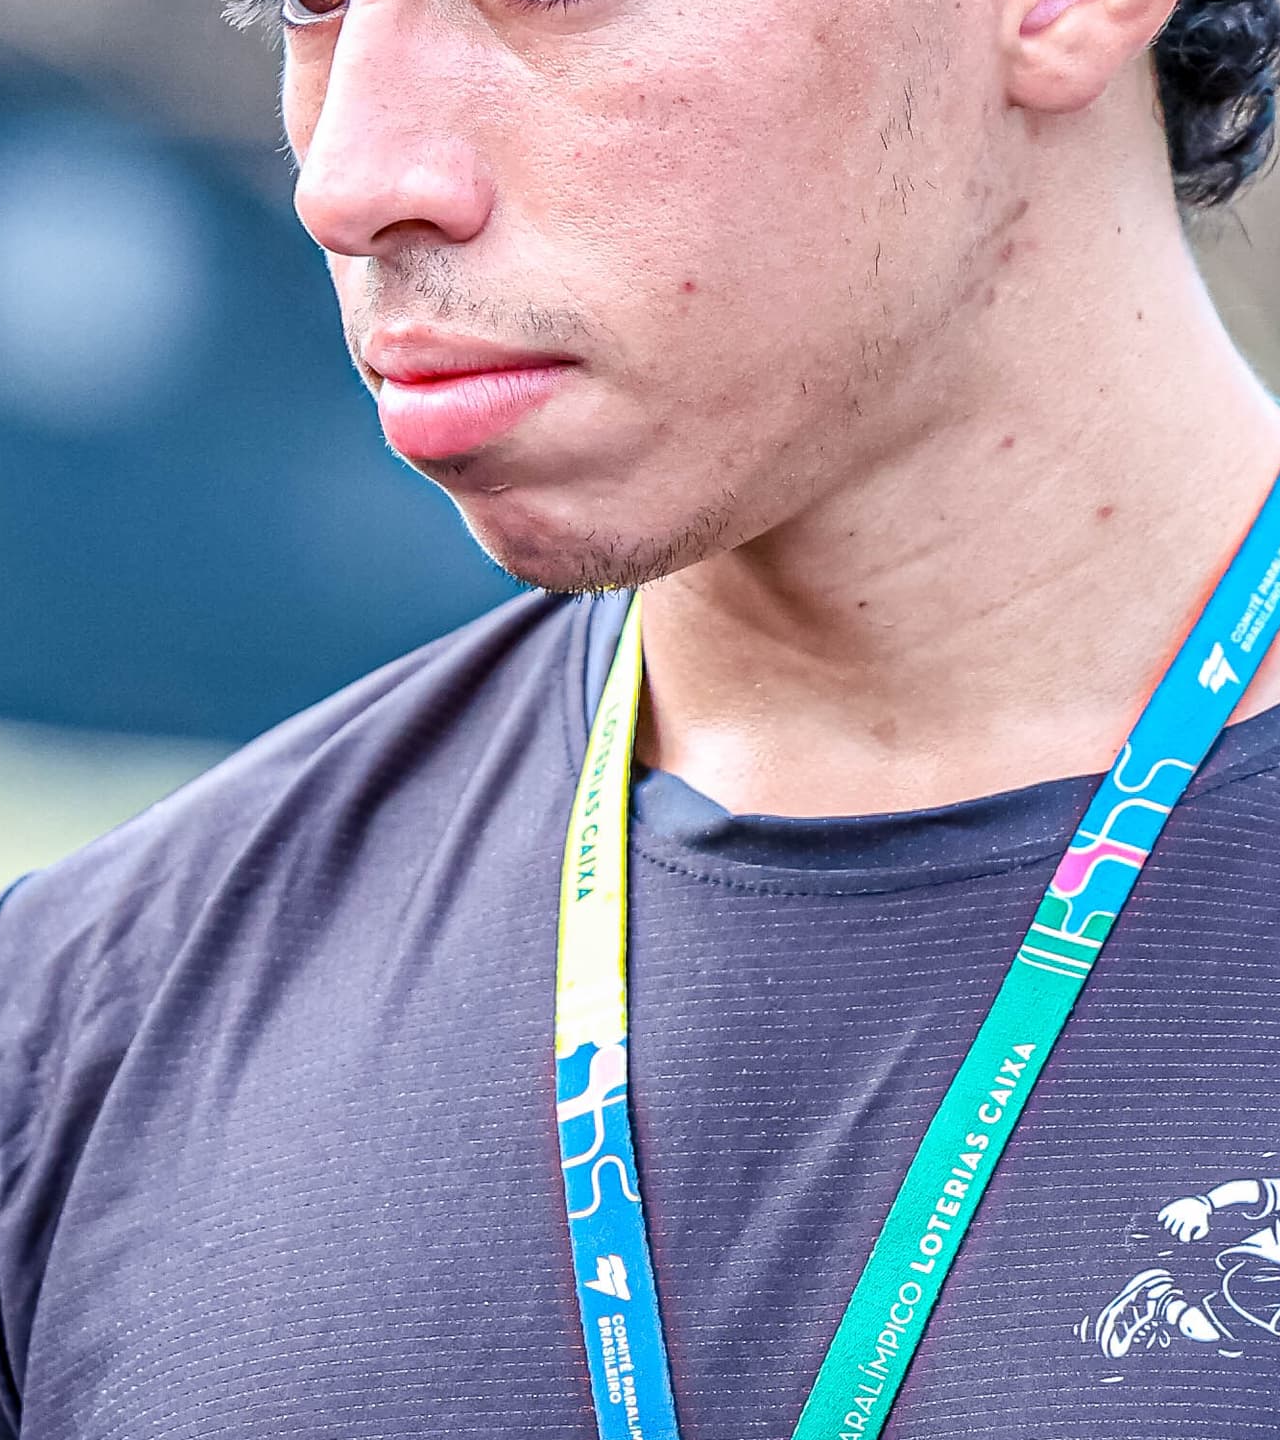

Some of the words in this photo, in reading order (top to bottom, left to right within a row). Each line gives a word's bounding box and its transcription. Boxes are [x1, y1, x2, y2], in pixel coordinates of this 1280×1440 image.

[576, 824, 599, 902] CAIXA
[910, 1132, 990, 1274] LOTERIAS
[978, 1043, 1037, 1124] CAIXA
[597, 1316, 622, 1404] BRASILEIRO
